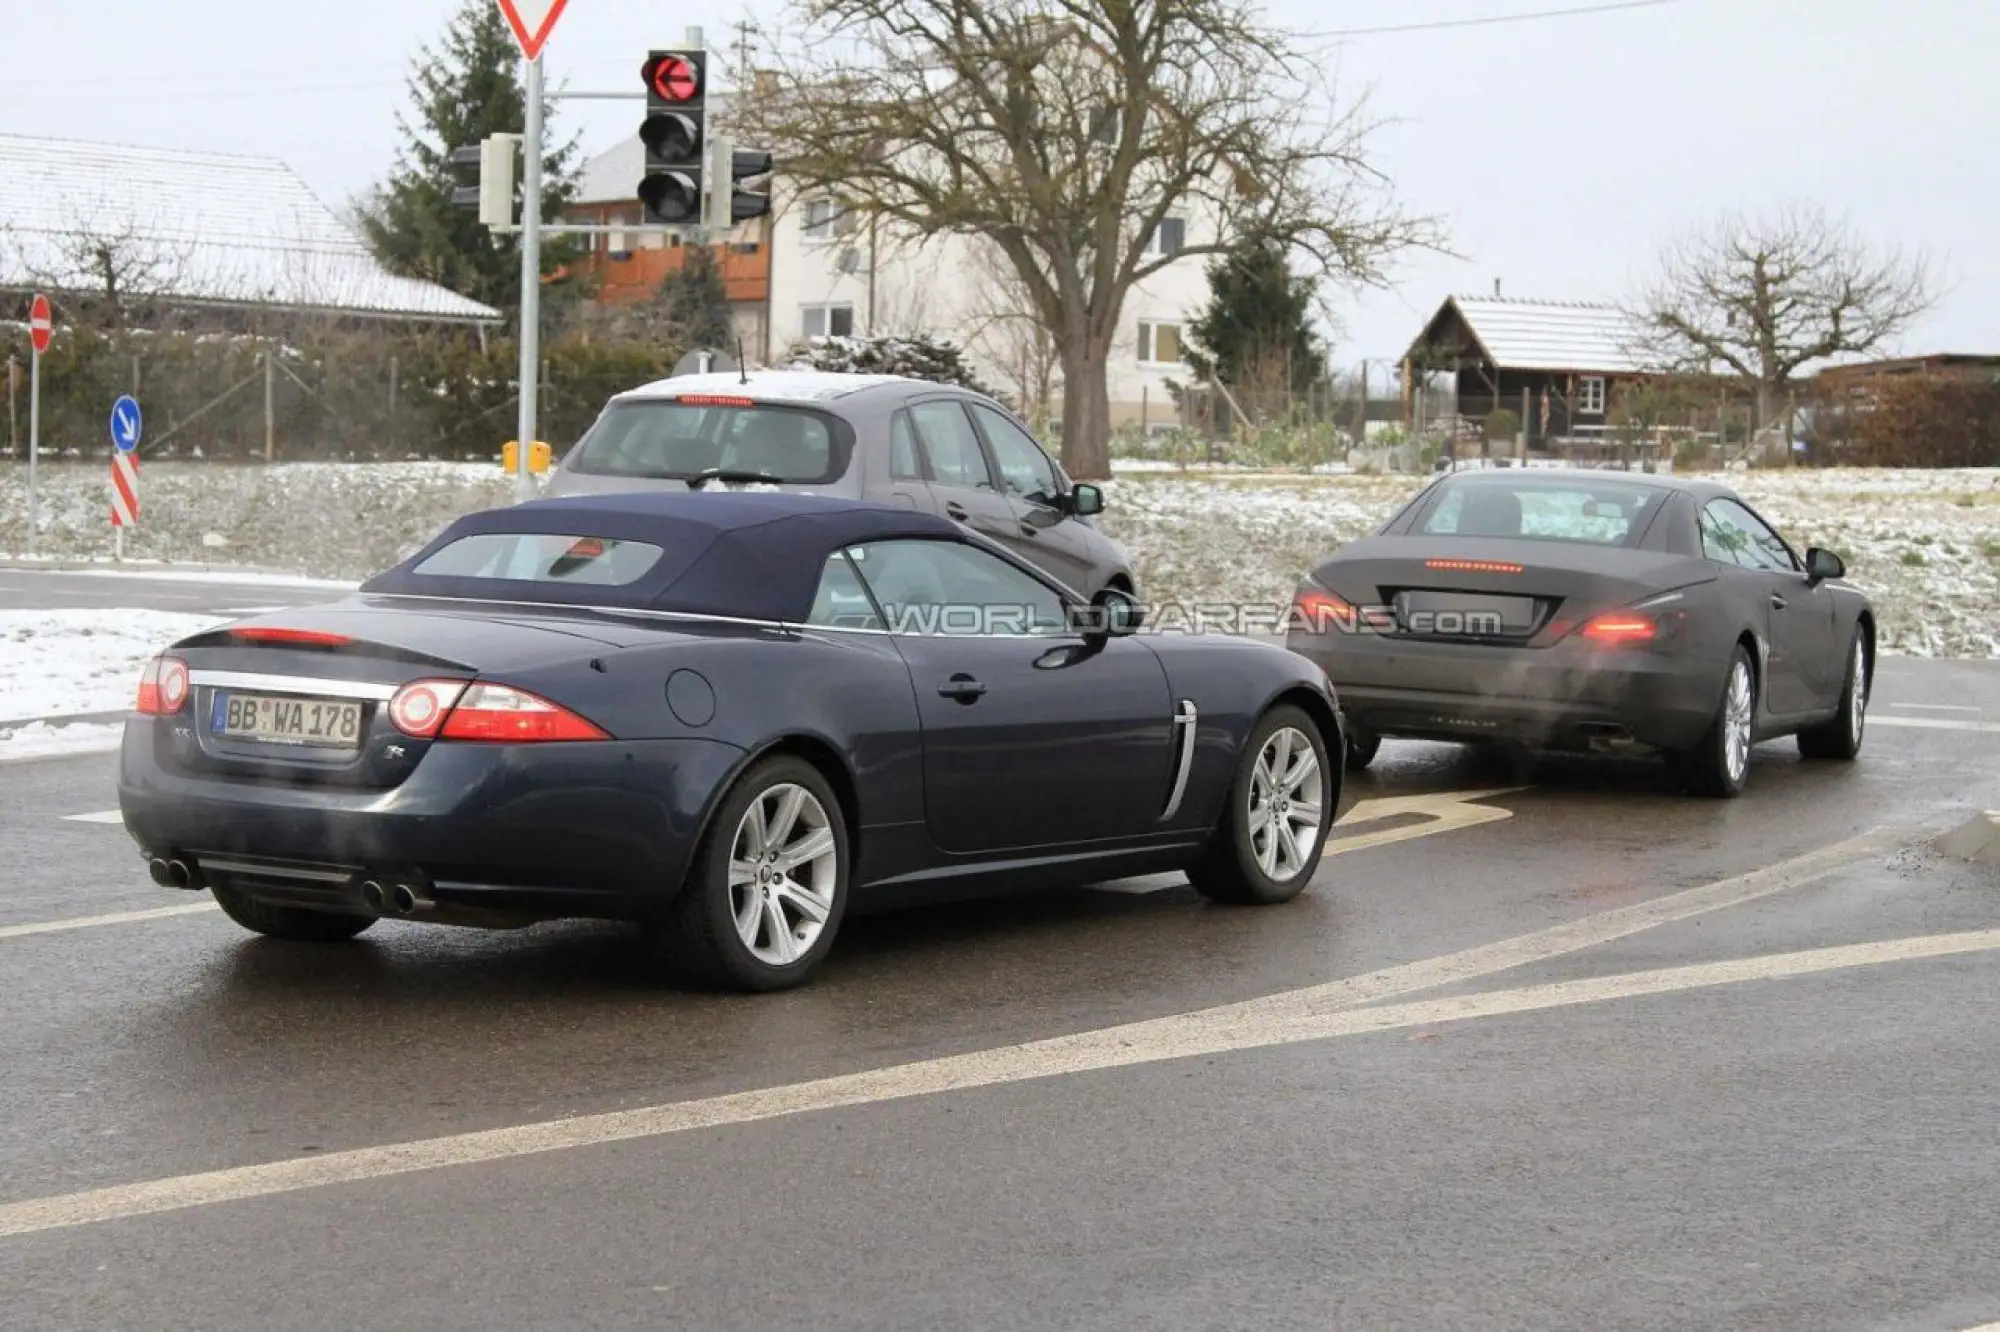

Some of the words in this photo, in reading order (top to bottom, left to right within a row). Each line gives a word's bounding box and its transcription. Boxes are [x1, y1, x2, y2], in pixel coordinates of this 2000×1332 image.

[228, 699, 258, 730] BB
[274, 702, 303, 733] WA
[308, 703, 357, 738] 178
